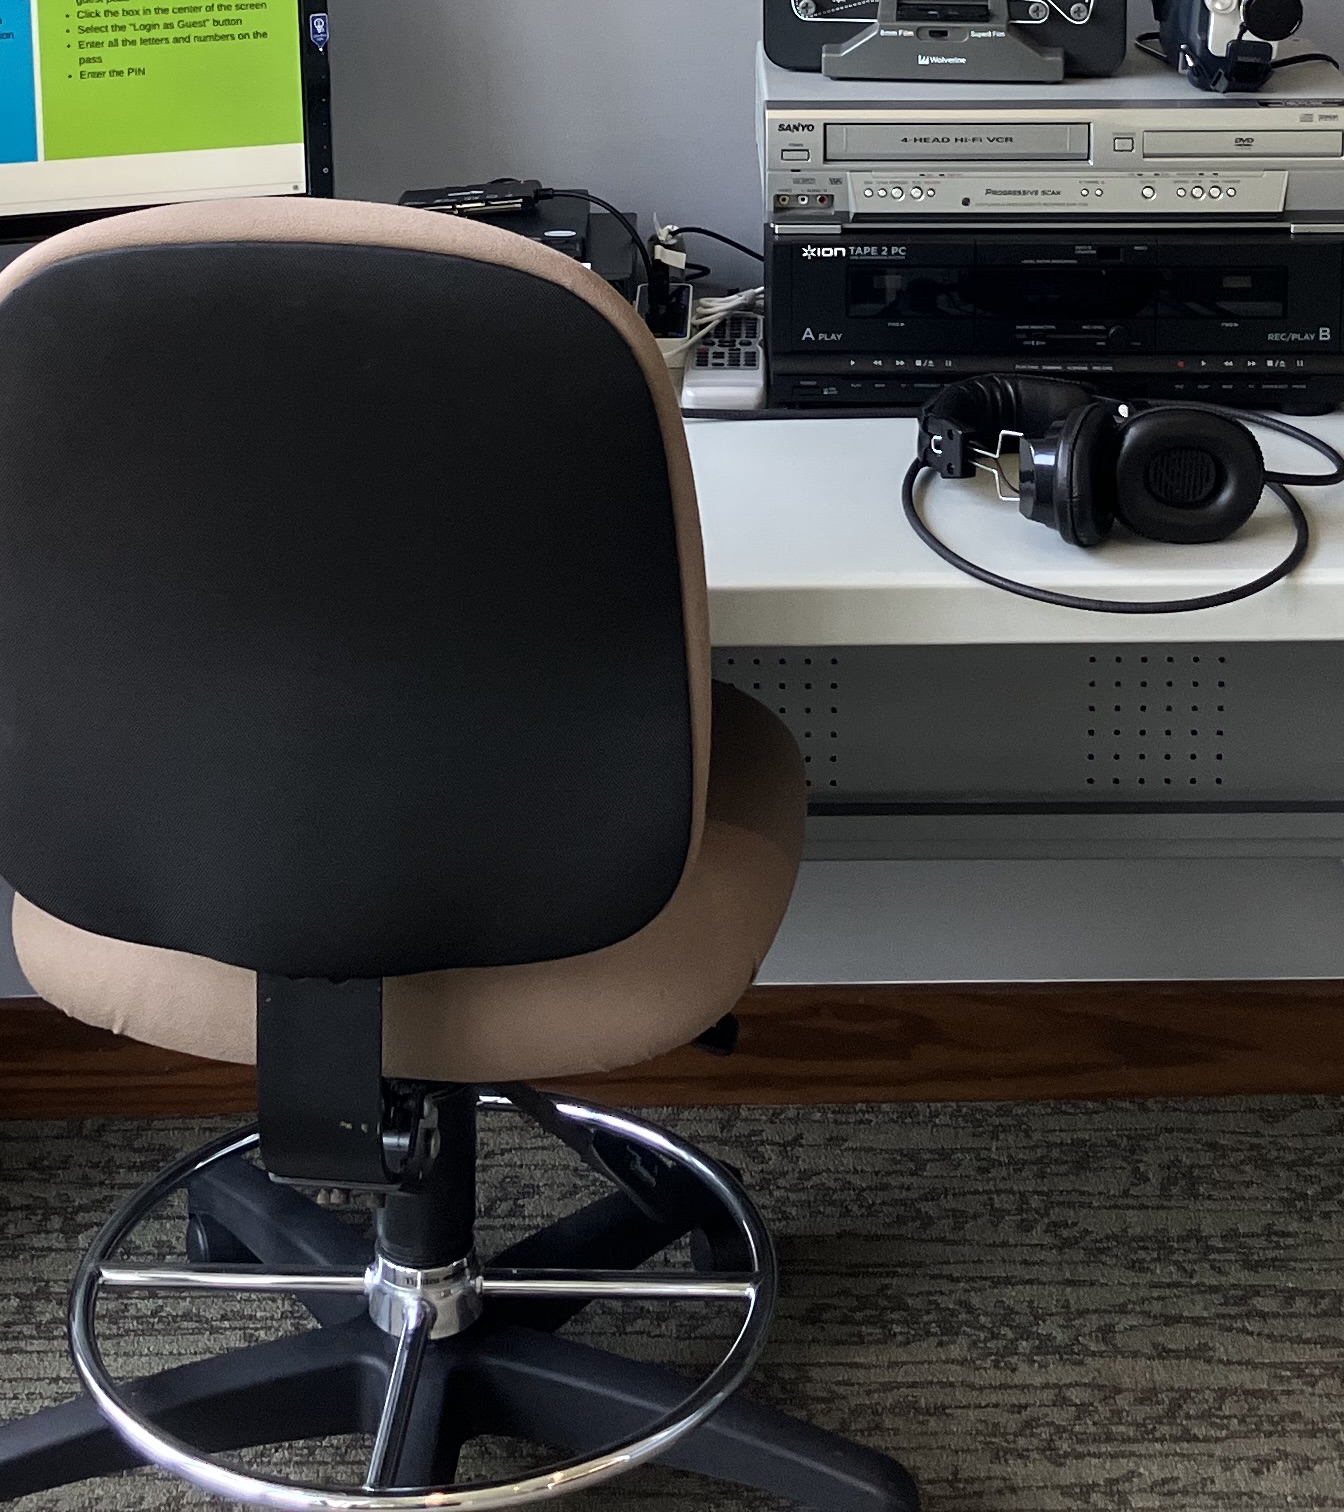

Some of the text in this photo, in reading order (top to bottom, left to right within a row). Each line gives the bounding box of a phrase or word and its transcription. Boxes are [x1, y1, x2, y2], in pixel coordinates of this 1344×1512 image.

[929, 56, 966, 65] Wolverine
[777, 123, 815, 133] SANYO
[900, 136, 951, 144] 4-HEAD
[986, 136, 1014, 144] VCR
[848, 246, 878, 255] TAPE
[881, 246, 888, 255] 2
[891, 246, 907, 255] PC
[801, 327, 843, 341] A PLAY
[1267, 327, 1331, 342] REC/PLAY B
